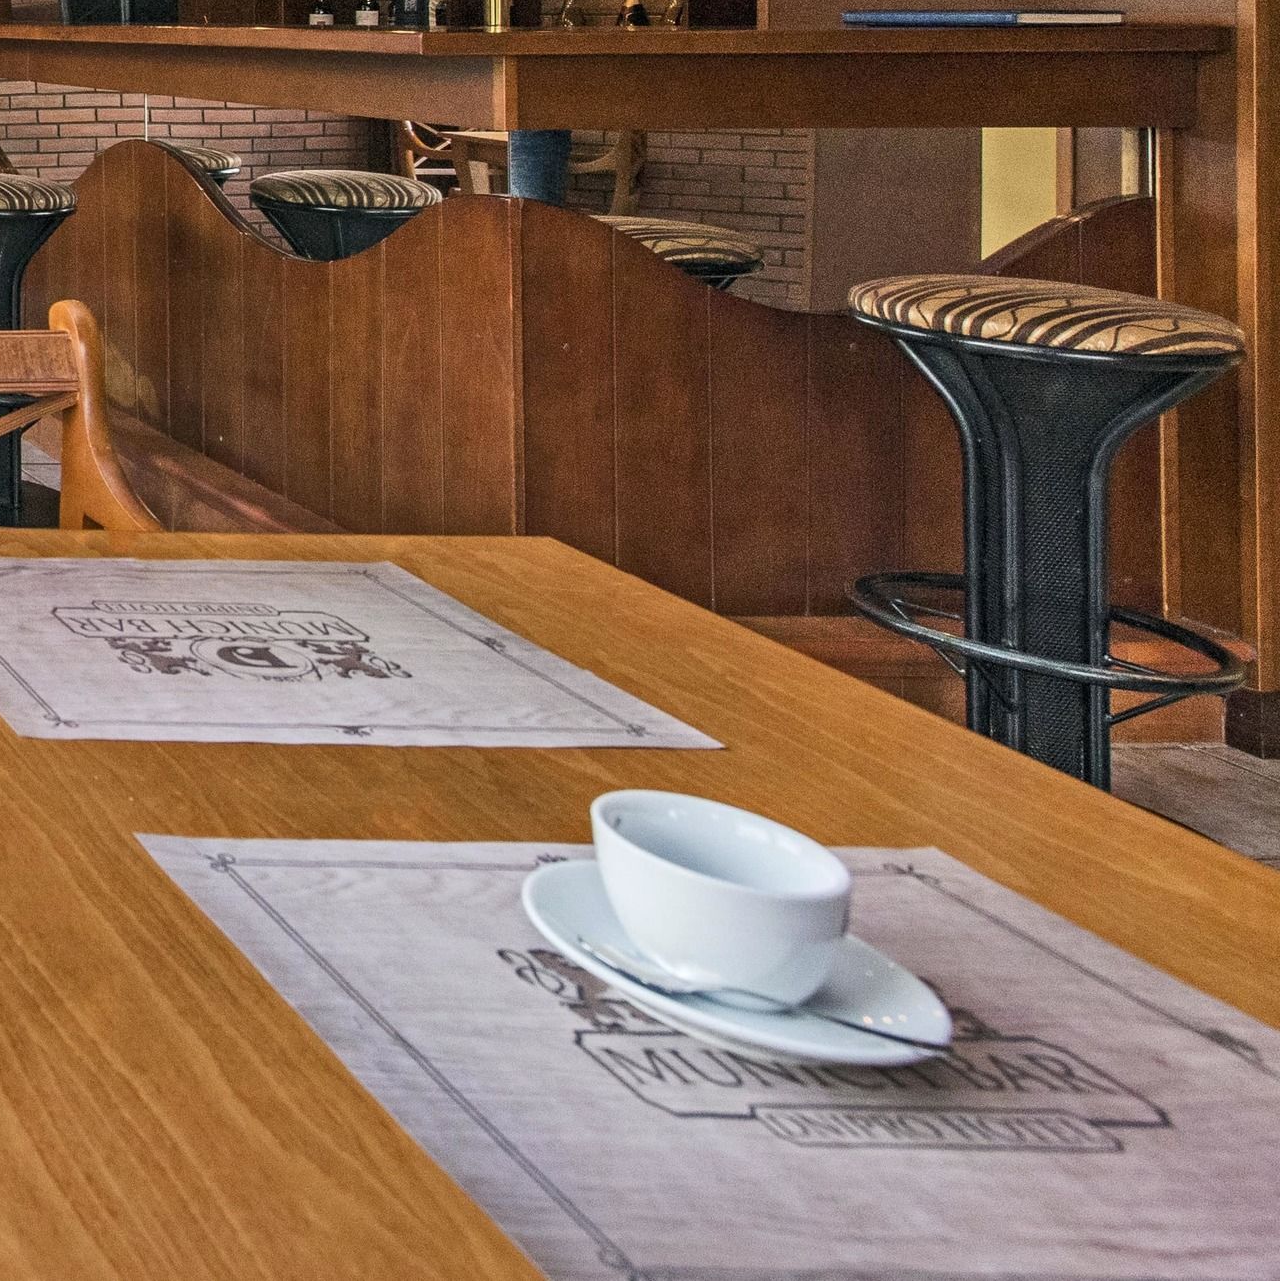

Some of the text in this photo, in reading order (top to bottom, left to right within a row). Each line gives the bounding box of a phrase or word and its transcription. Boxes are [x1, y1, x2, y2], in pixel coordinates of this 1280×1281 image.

[68, 617, 354, 636] MUNICH BAR
[952, 1053, 1123, 1094] BAR
